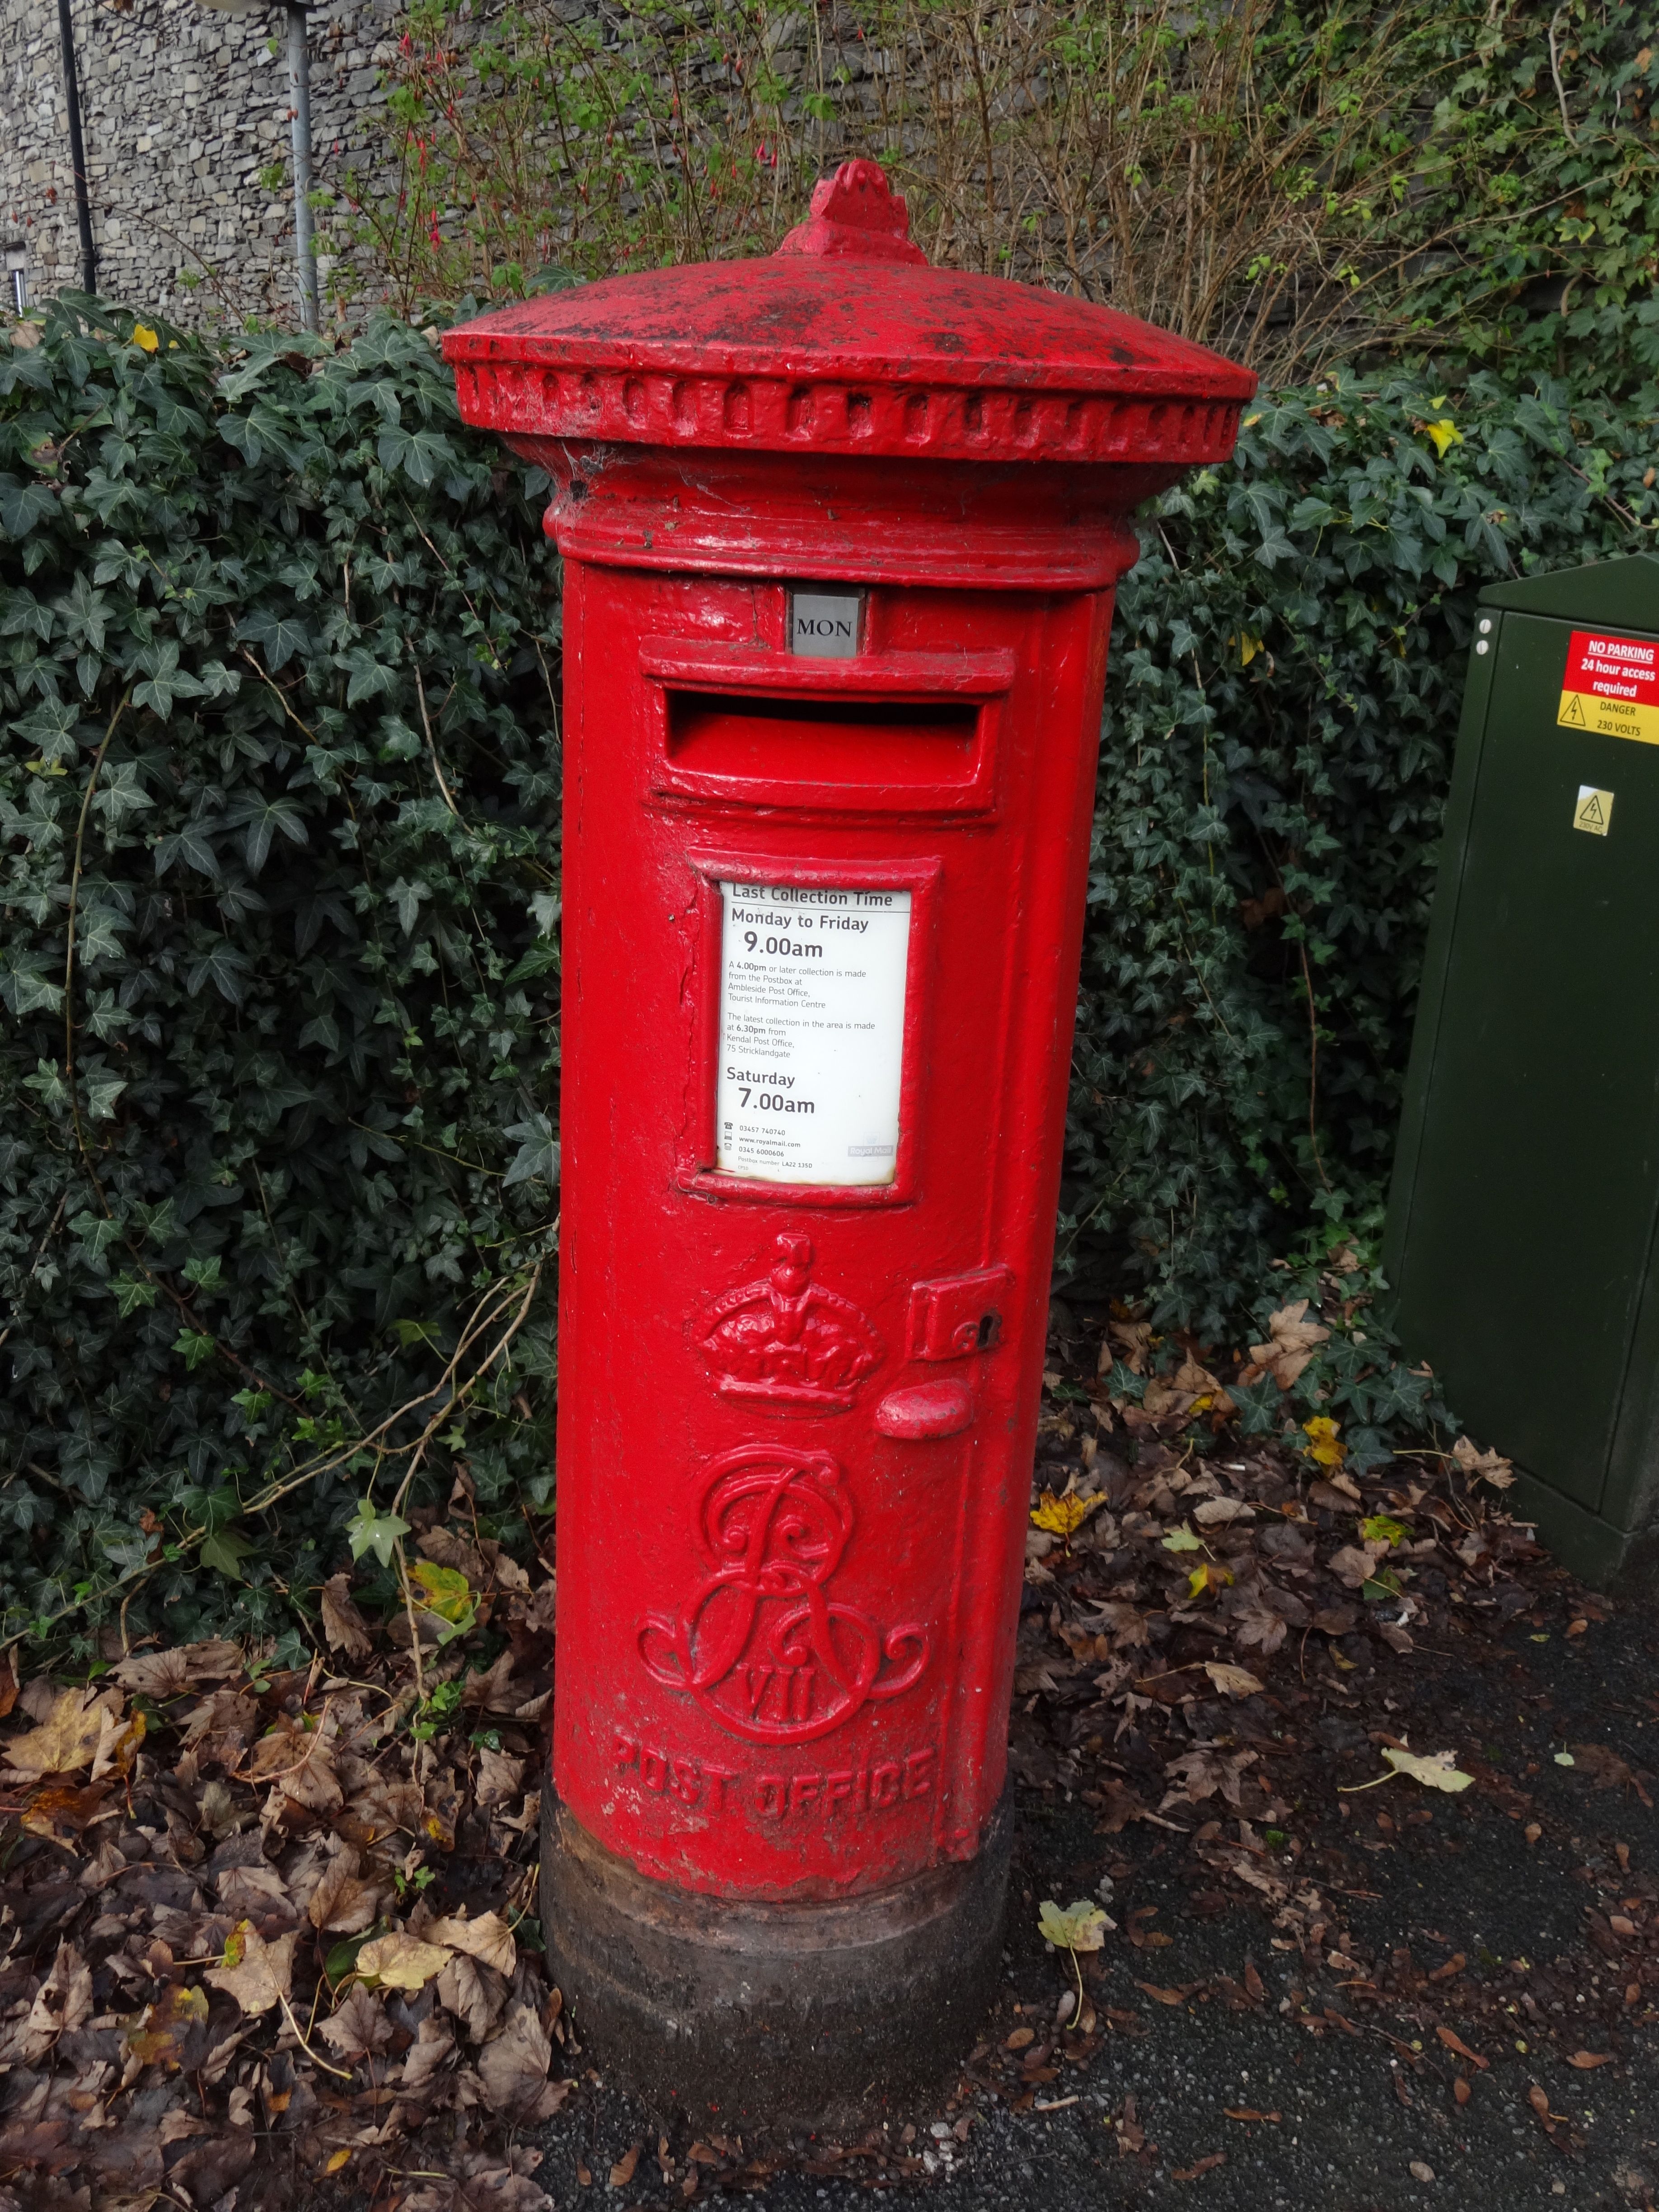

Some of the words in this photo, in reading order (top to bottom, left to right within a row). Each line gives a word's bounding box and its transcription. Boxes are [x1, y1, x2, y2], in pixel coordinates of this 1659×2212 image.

[797, 619, 852, 637] MON
[1589, 640, 1605, 652] NO
[1607, 643, 1654, 661] PARKING
[1581, 658, 1594, 670] 24
[1596, 660, 1621, 675] hour
[1622, 666, 1655, 681] access
[1593, 681, 1637, 698] required
[1600, 702, 1636, 716] DANGER
[1597, 720, 1612, 731] 230
[1615, 723, 1641, 736] VOLTS
[1579, 821, 1593, 830] 230V
[732, 883, 765, 899] Last
[771, 887, 848, 905] Collection
[853, 891, 892, 906] Time
[732, 908, 792, 928] Monday
[798, 915, 813, 928] to
[820, 915, 869, 933] Friday
[744, 931, 823, 958] 9.00am
[737, 961, 766, 972] 4.00pm
[779, 966, 797, 974] later
[799, 968, 834, 976] collection
[729, 972, 746, 980] from
[763, 975, 792, 984] Postbox
[728, 982, 766, 993] Ambleside
[769, 986, 785, 995] Post
[787, 988, 810, 998] Office,
[728, 993, 753, 1003] Tourist
[755, 996, 798, 1007] Information
[801, 1000, 826, 1008] Centre
[727, 1012, 741, 1021] The
[744, 1015, 764, 1023] latest
[765, 1017, 800, 1026] collection
[736, 1024, 766, 1035] 6.30pm
[769, 1027, 786, 1036] from
[727, 1034, 751, 1043] Kendal
[754, 1036, 769, 1045] Post
[772, 1039, 795, 1048] Office,
[726, 1044, 736, 1052] 75
[738, 1045, 791, 1059] Stricklandgate
[727, 1067, 795, 1088] Saturday
[738, 1087, 815, 1113] 7.00am
[739, 1137, 801, 1148] www.royalmail.com
[850, 1147, 872, 1156] Royal
[613, 1735, 734, 1806] POST
[755, 1748, 936, 1819] OFFICE
